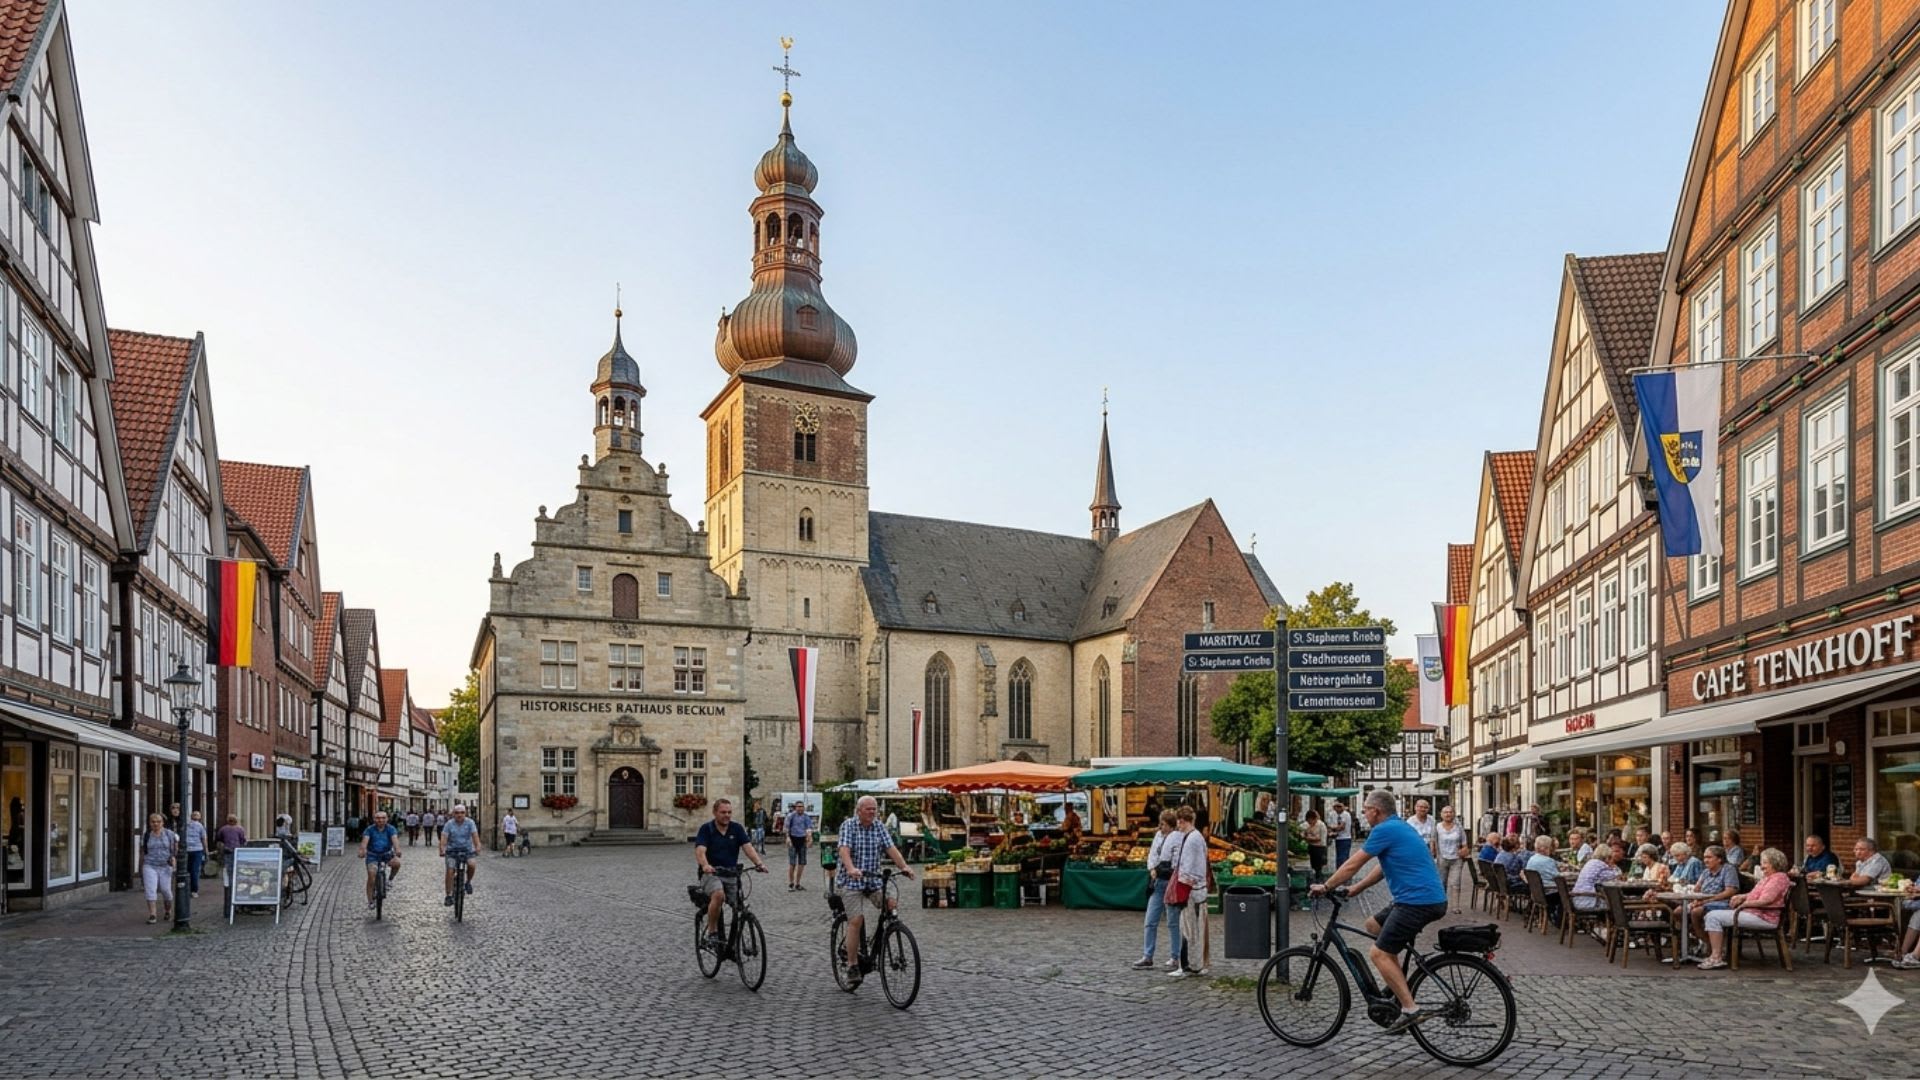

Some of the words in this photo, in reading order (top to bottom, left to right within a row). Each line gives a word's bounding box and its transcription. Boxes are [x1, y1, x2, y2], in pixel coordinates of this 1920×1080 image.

[1754, 614, 1914, 687] TENKHOFF
[520, 700, 612, 713] HISTORISCHES
[616, 703, 672, 715] RATHAUS
[677, 705, 726, 716] BECKUM
